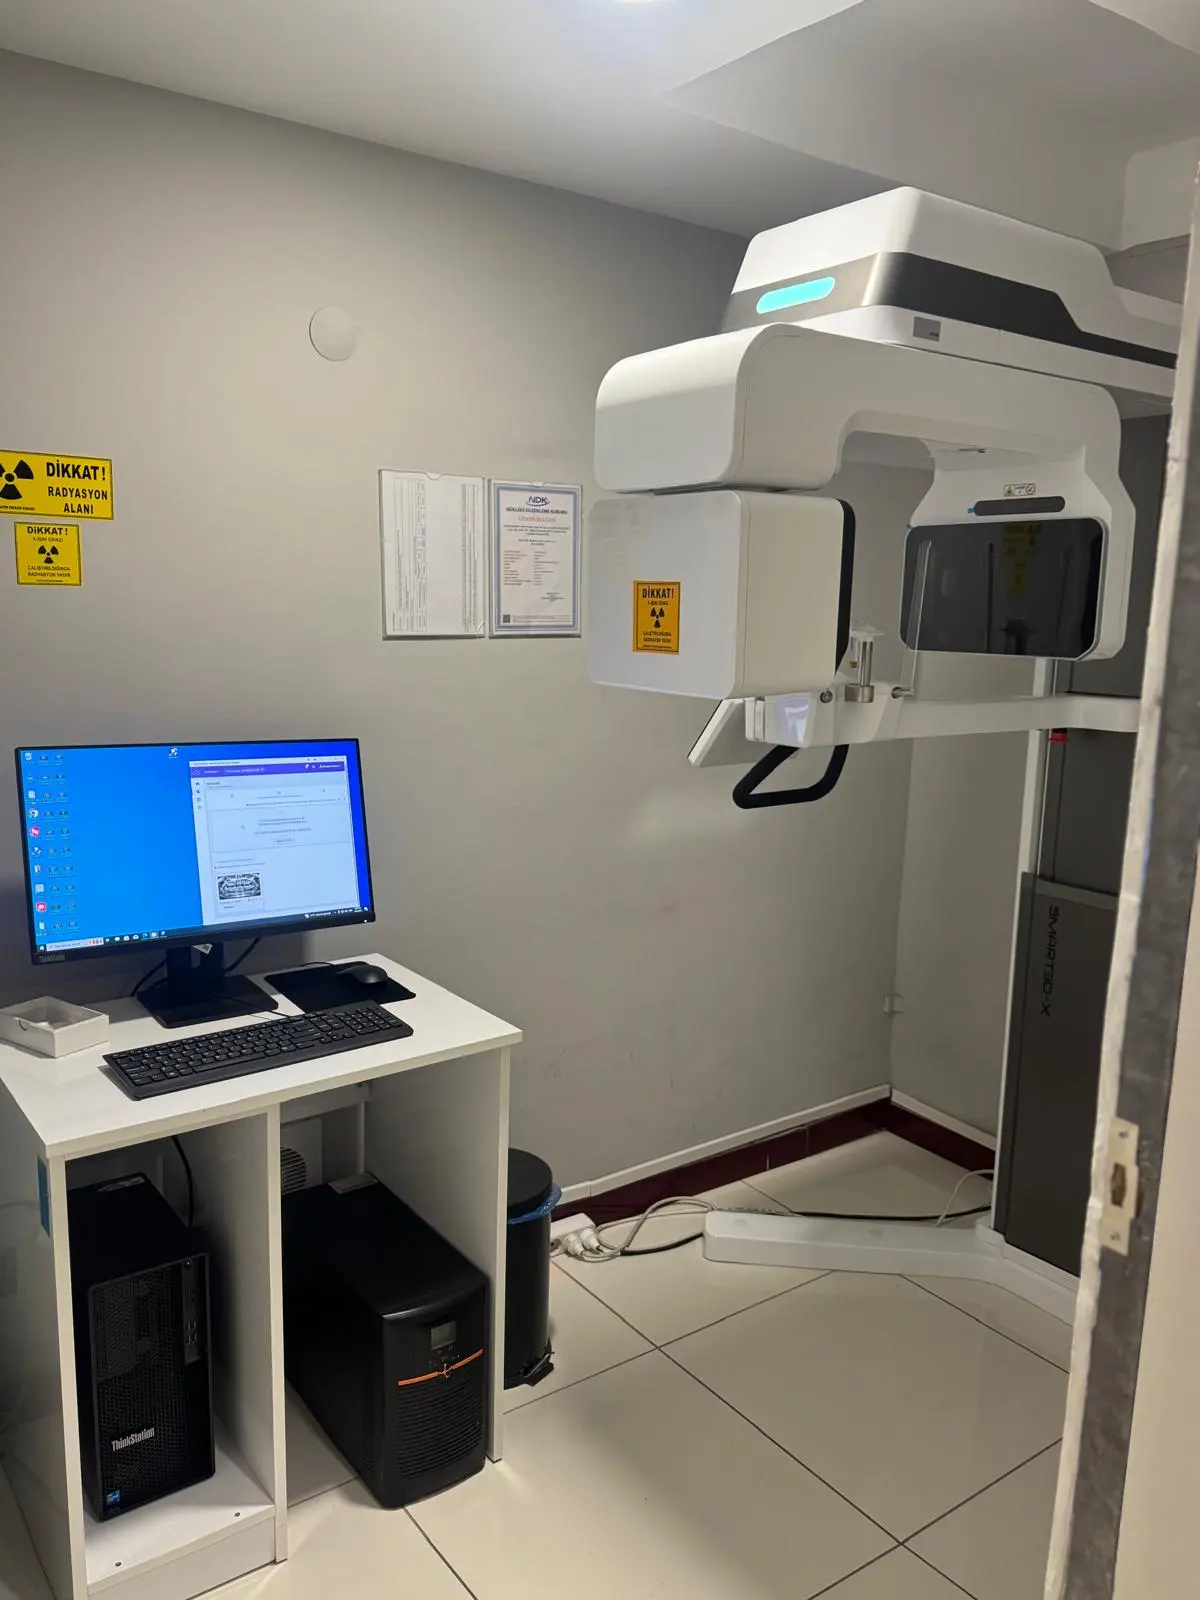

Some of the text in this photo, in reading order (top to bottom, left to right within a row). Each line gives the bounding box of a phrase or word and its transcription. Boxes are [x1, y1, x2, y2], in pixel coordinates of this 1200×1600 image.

[48, 486, 108, 500] RADYASYON
[528, 496, 549, 504] NDK
[63, 503, 94, 515] ALANI
[111, 1427, 155, 1452] ThinkStation
